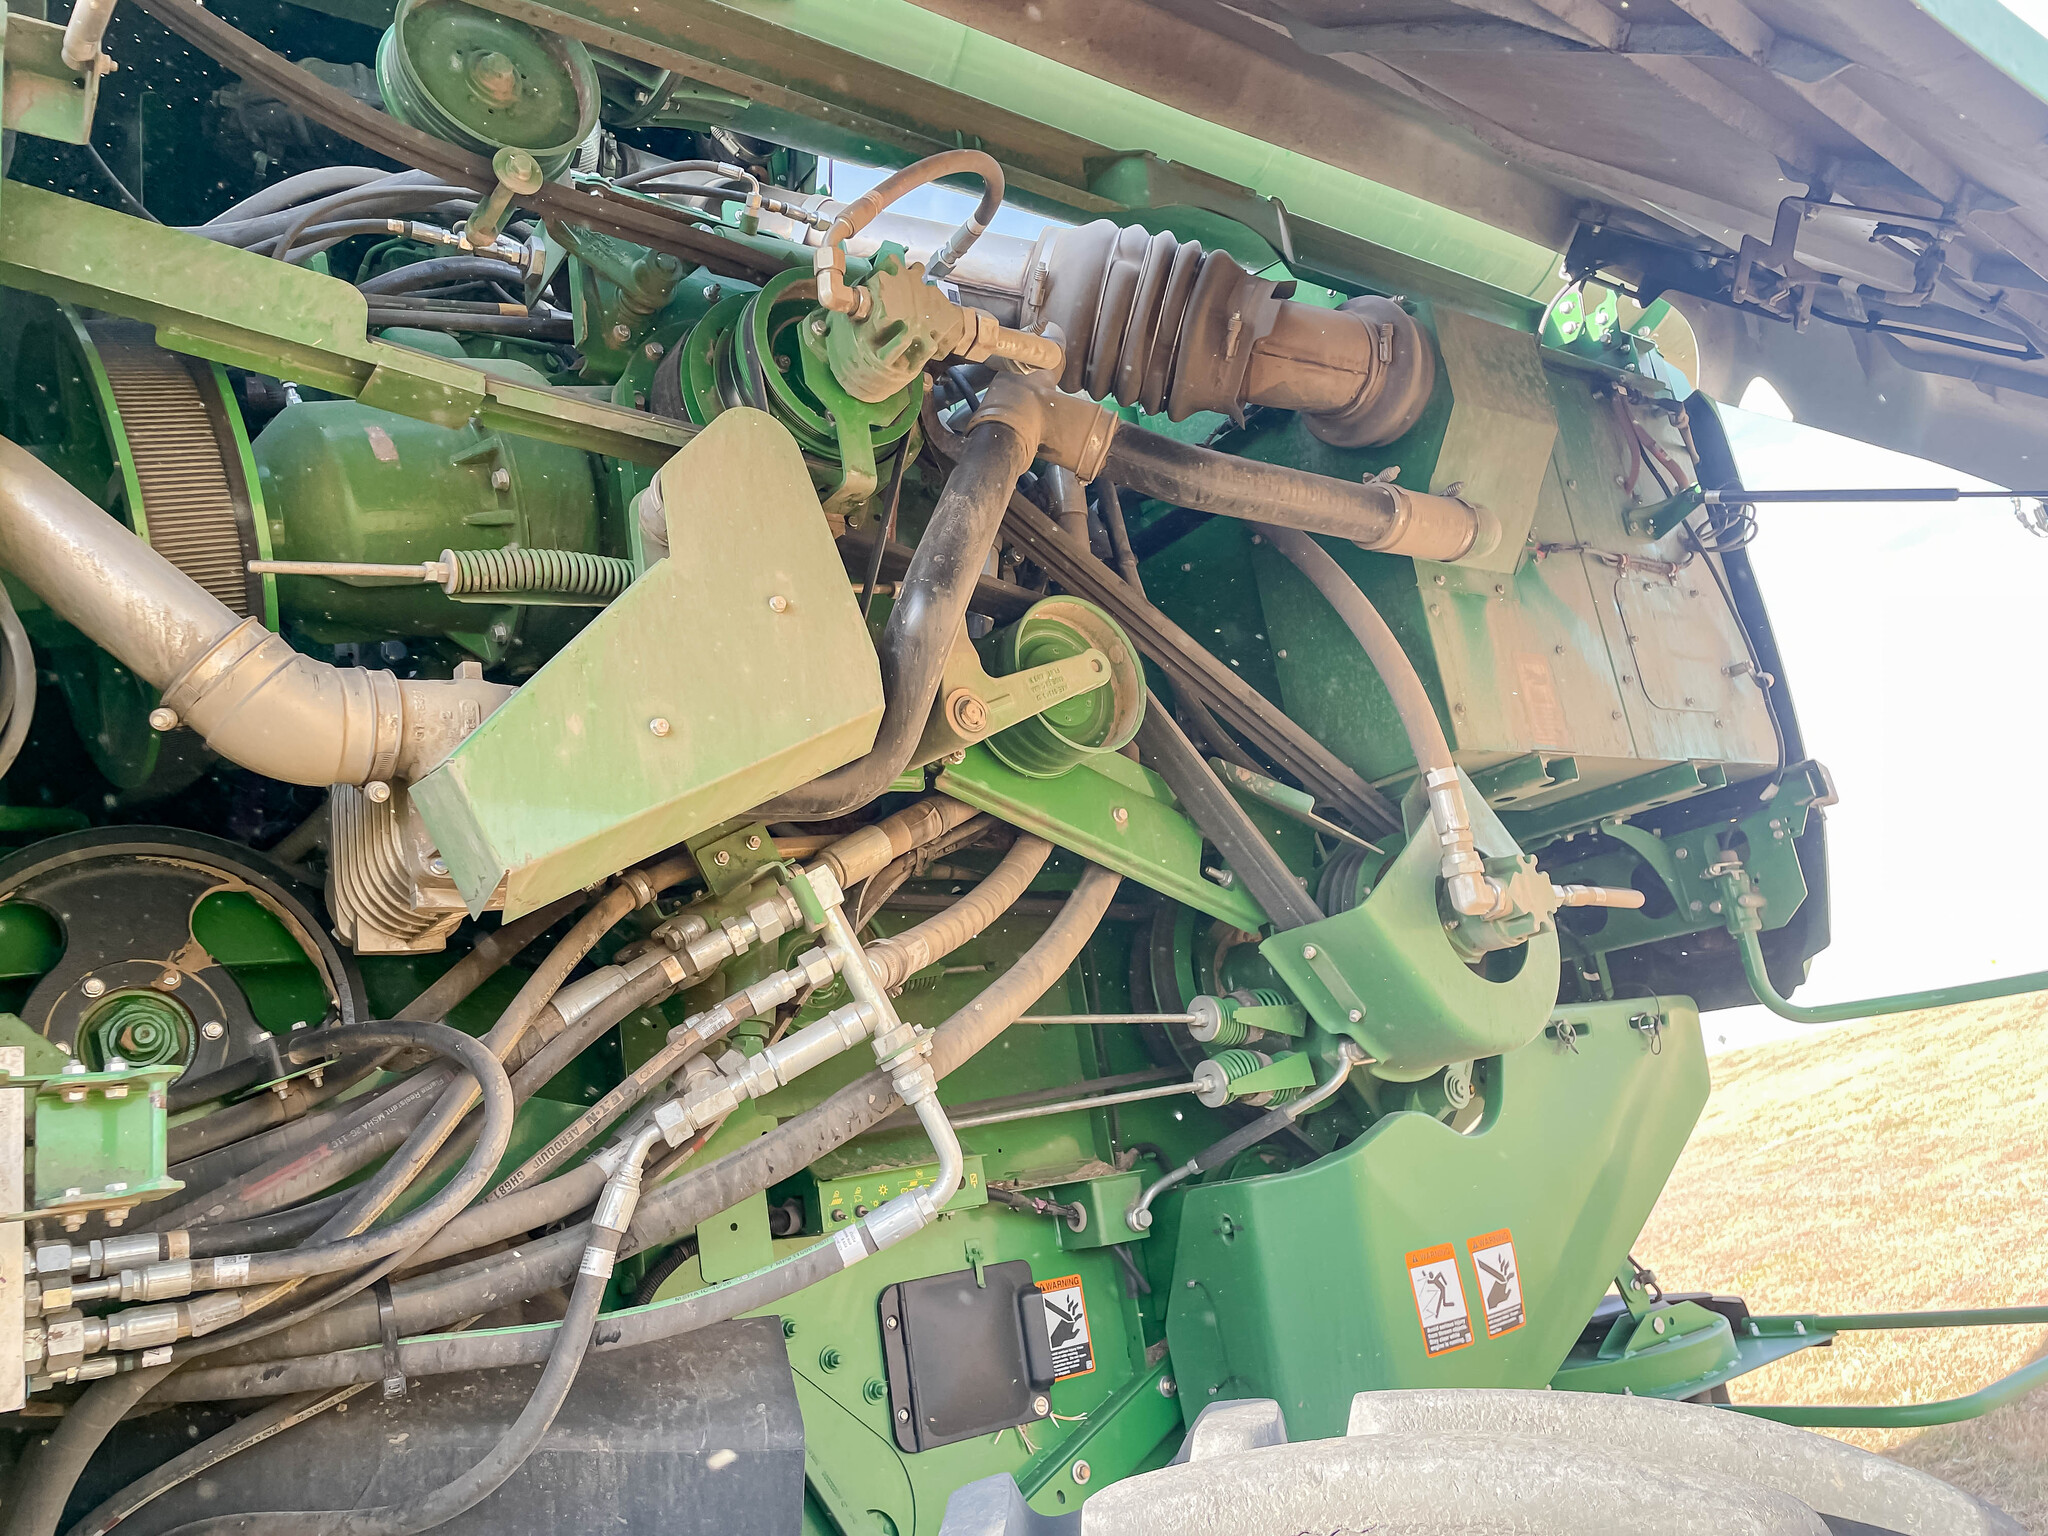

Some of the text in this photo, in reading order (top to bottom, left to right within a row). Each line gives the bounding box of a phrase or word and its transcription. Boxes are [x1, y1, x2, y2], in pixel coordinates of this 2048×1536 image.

[419, 1076, 444, 1094] Flame
[384, 1090, 421, 1116] Resistant
[360, 1111, 385, 1130] MSHA
[530, 1125, 580, 1170] AEROQUIP
[1478, 1232, 1509, 1247] WARNING
[1420, 1247, 1451, 1261] WARNING
[1045, 1276, 1080, 1291] WARNING
